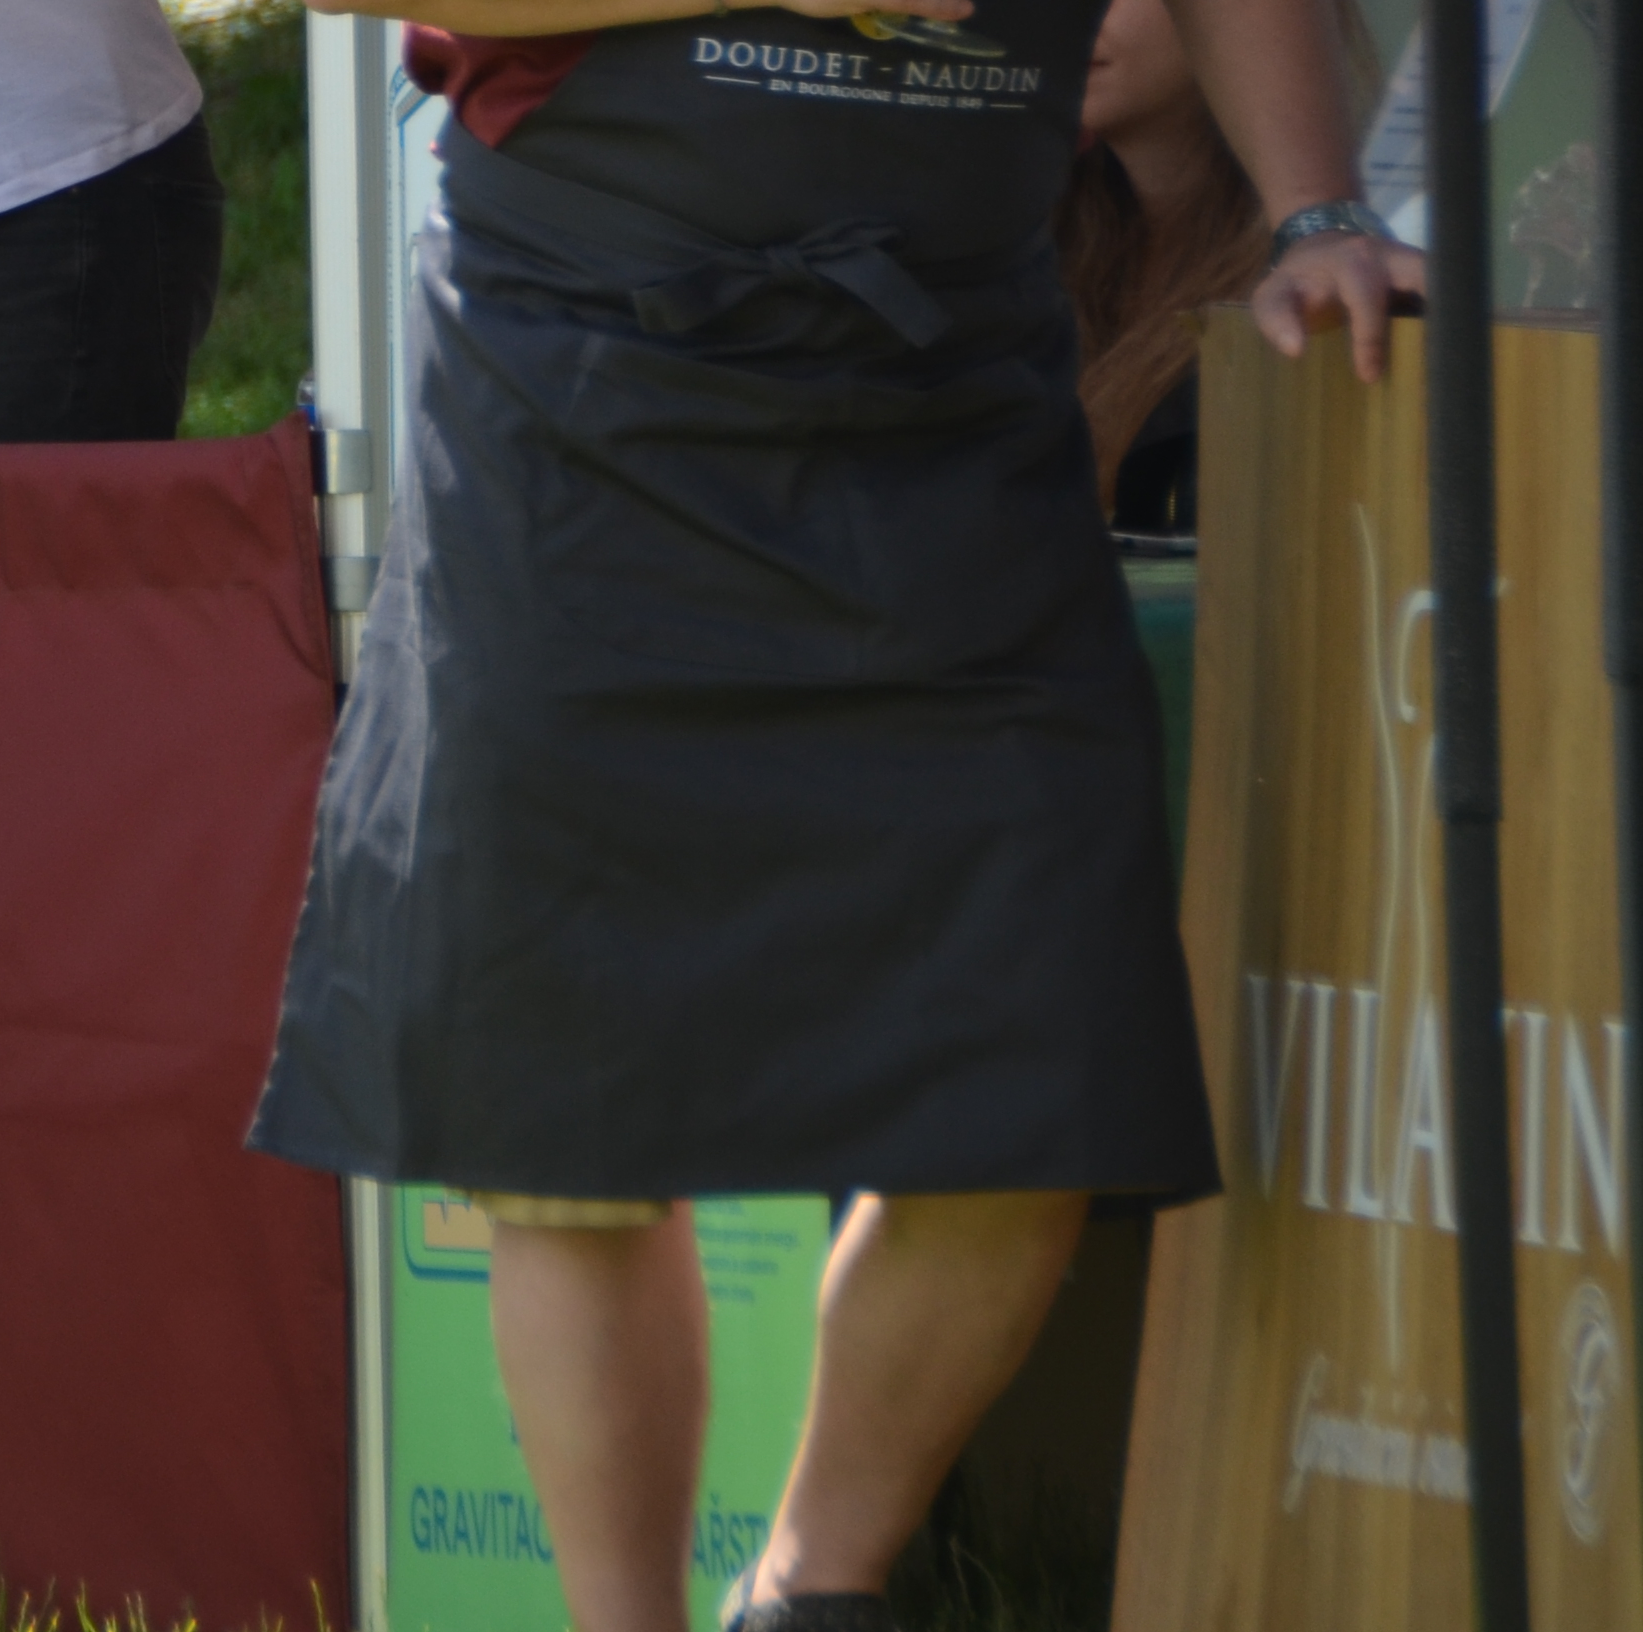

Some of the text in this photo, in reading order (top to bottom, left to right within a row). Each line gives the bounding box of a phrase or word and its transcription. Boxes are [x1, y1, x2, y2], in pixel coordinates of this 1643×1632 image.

[695, 37, 869, 79] DOUDET
[903, 60, 1041, 93] NAUDIN
[768, 78, 792, 92] EN
[797, 81, 892, 103] BOURGOGNE
[899, 91, 950, 108] DEPUIS
[1245, 971, 1630, 1258] VILAIN
